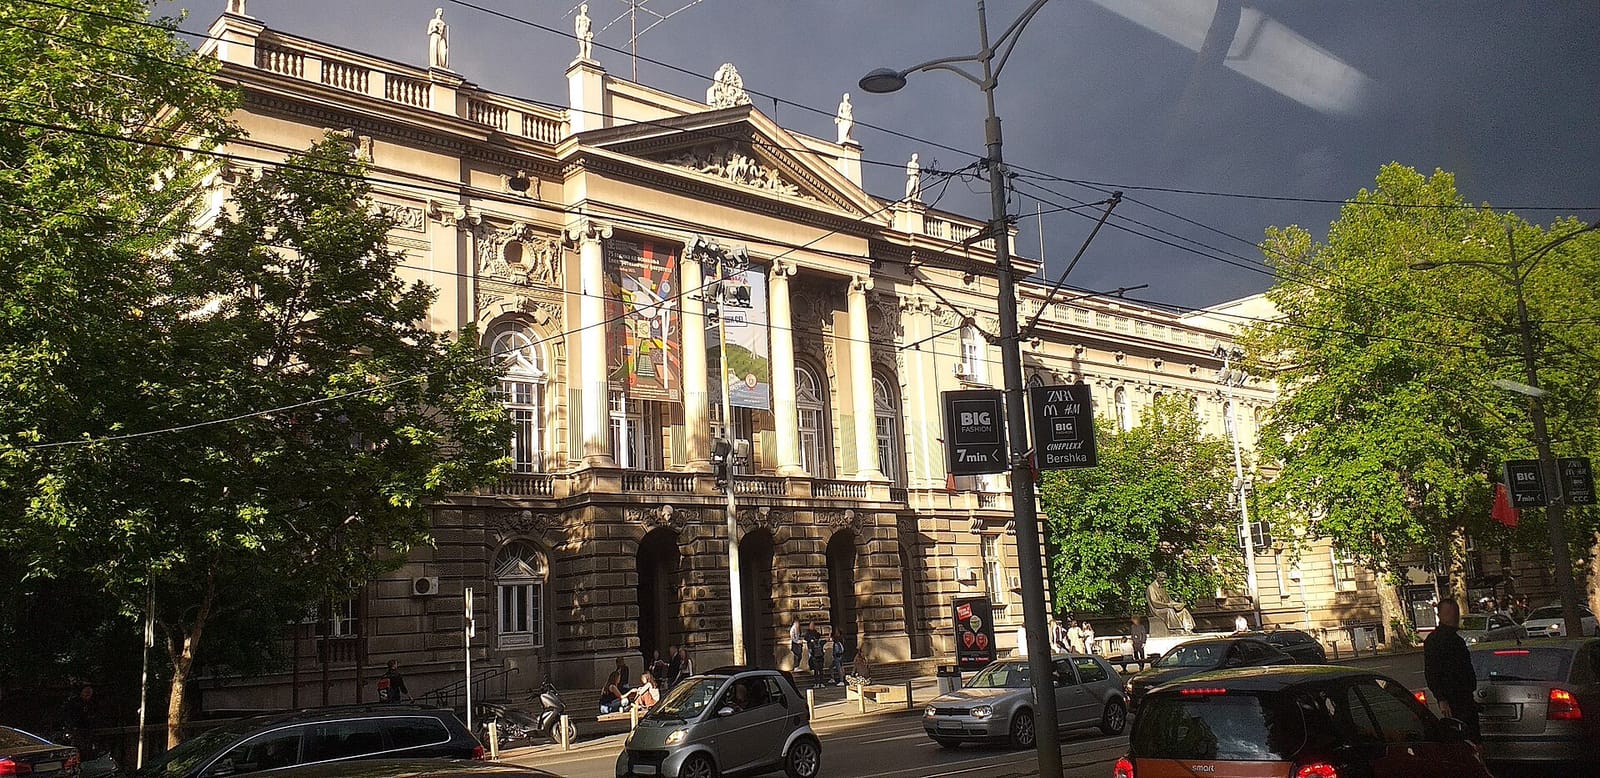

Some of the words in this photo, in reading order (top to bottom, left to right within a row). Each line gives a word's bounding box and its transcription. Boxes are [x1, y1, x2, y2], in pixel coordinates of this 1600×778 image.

[1047, 390, 1075, 402] ZARA
[960, 411, 991, 426] BIG
[961, 425, 992, 433] FASHION
[1055, 423, 1073, 431] BIG
[1046, 440, 1084, 451] CINEPLEXX
[1046, 452, 1087, 464] Bershka
[1516, 472, 1536, 481] BIG
